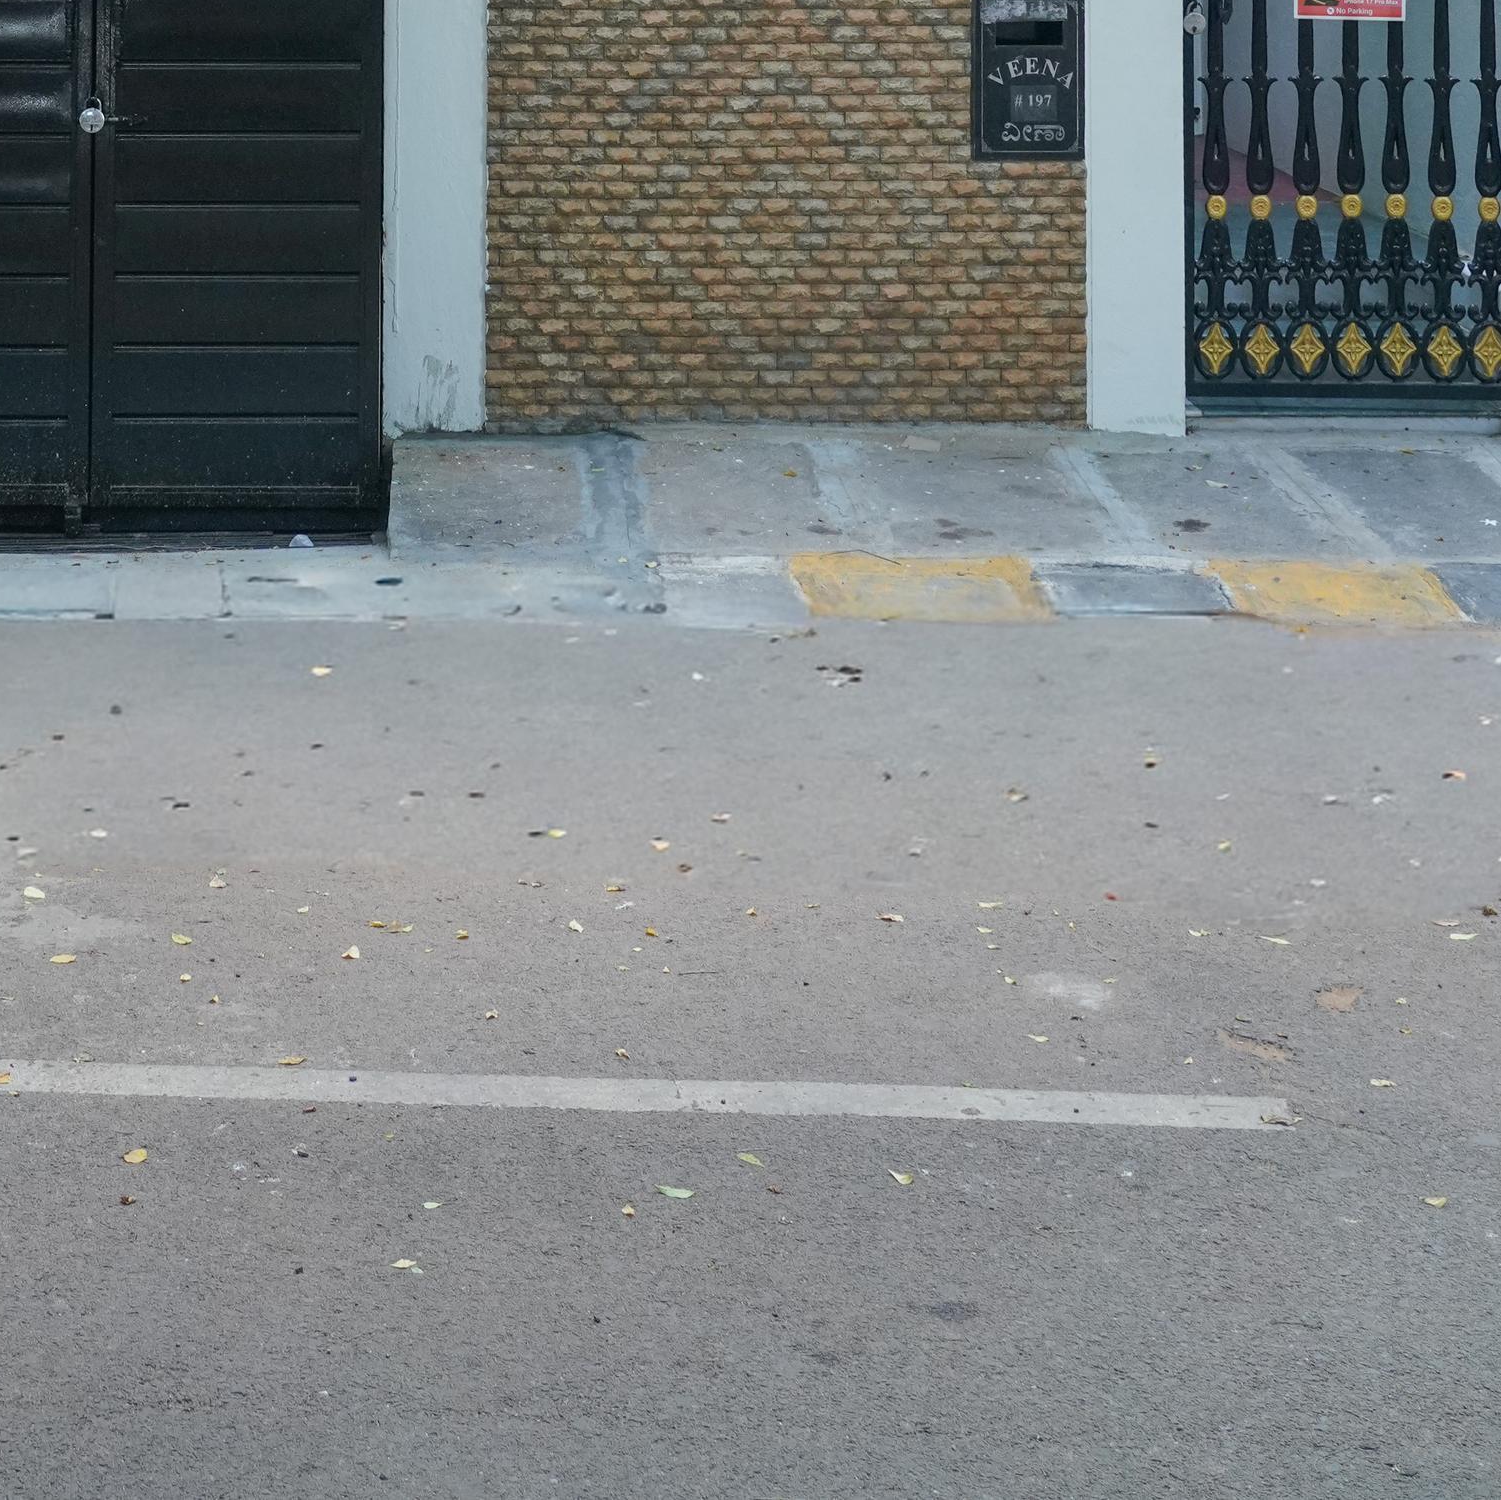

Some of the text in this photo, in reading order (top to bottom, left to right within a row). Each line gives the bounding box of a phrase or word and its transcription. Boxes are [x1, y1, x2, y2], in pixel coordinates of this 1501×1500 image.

[1347, 8, 1373, 16] Parking
[987, 56, 1074, 89] VEENA
[1013, 94, 1052, 107] # 197
[1001, 122, 1066, 142] ವೀಣಾ
